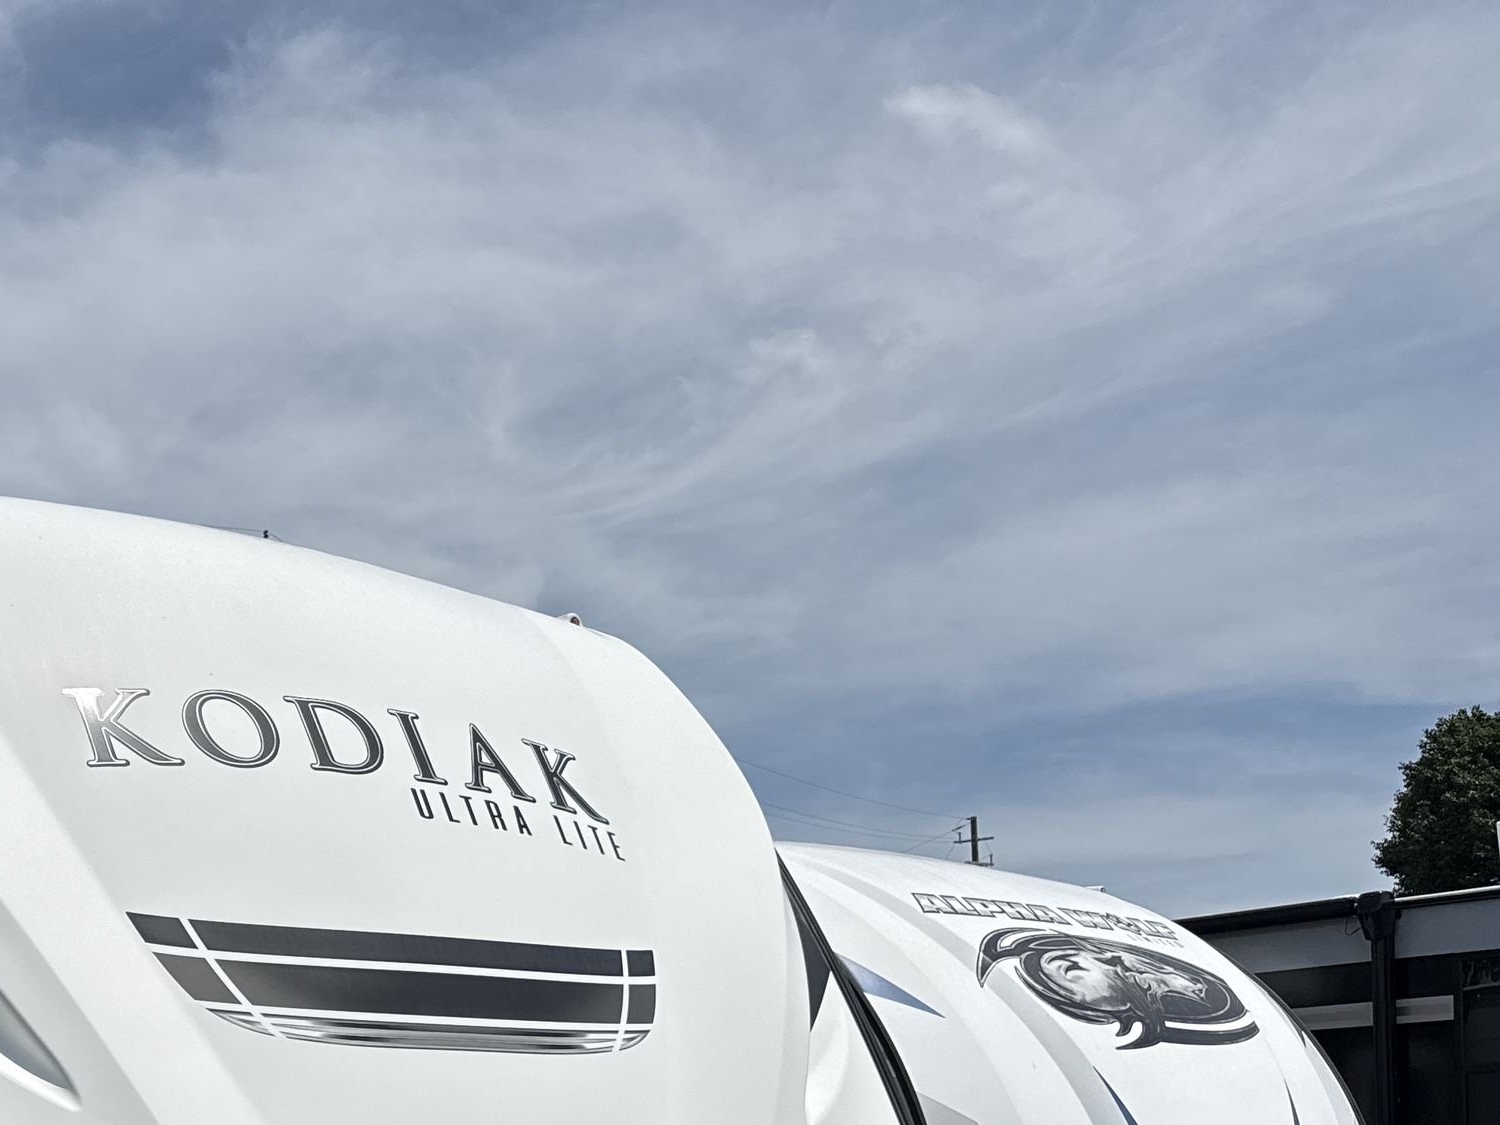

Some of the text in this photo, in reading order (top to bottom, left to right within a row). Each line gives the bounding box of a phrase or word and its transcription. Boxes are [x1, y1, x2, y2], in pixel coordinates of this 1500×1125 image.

[61, 687, 610, 825] KODIAK
[410, 787, 626, 862] ULTRA LITE
[911, 892, 1071, 925] ALPHA
